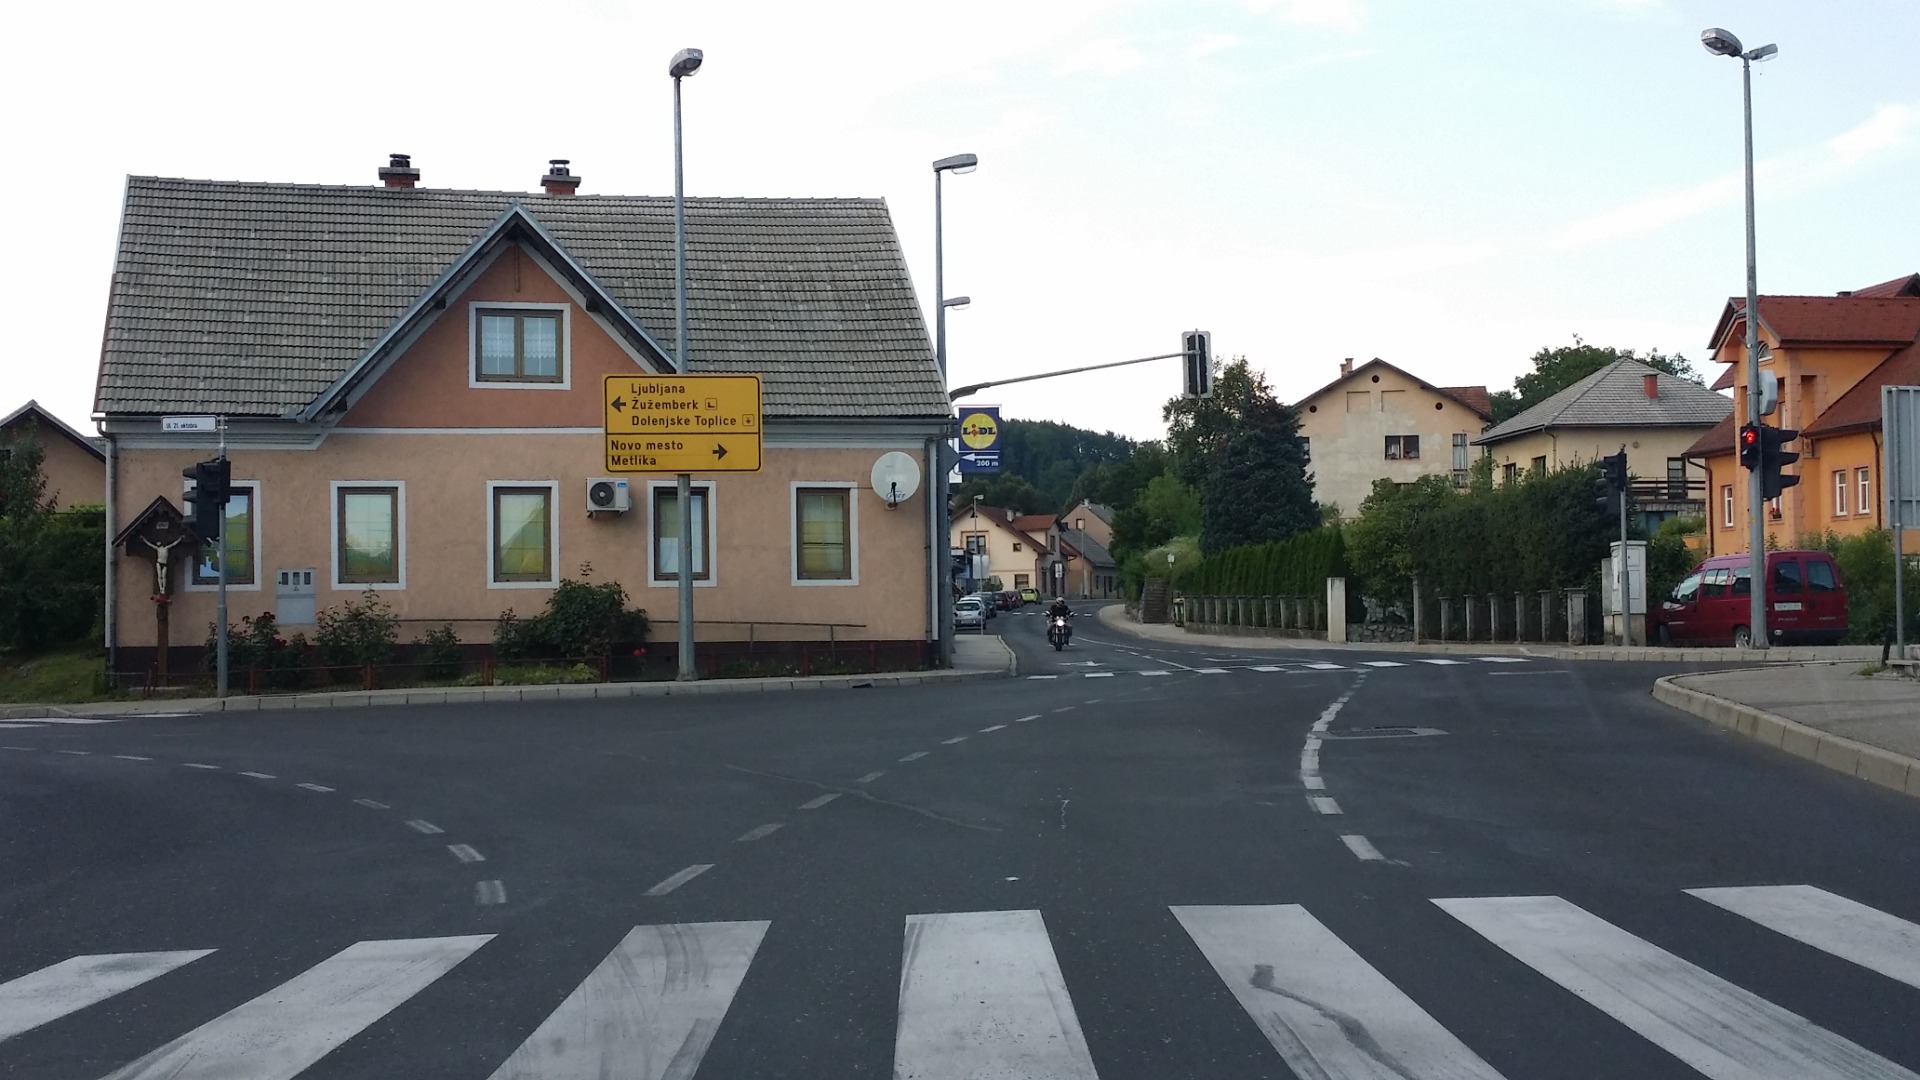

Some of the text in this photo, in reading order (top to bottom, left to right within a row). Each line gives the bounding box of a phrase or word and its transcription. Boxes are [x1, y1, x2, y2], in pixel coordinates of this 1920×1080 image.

[631, 383, 685, 396] Ljubljana
[631, 397, 699, 410] Žužemberk
[631, 415, 737, 428] Dolenjske Toplice
[611, 440, 684, 451] Novo mesto
[611, 455, 657, 466] Metlika
